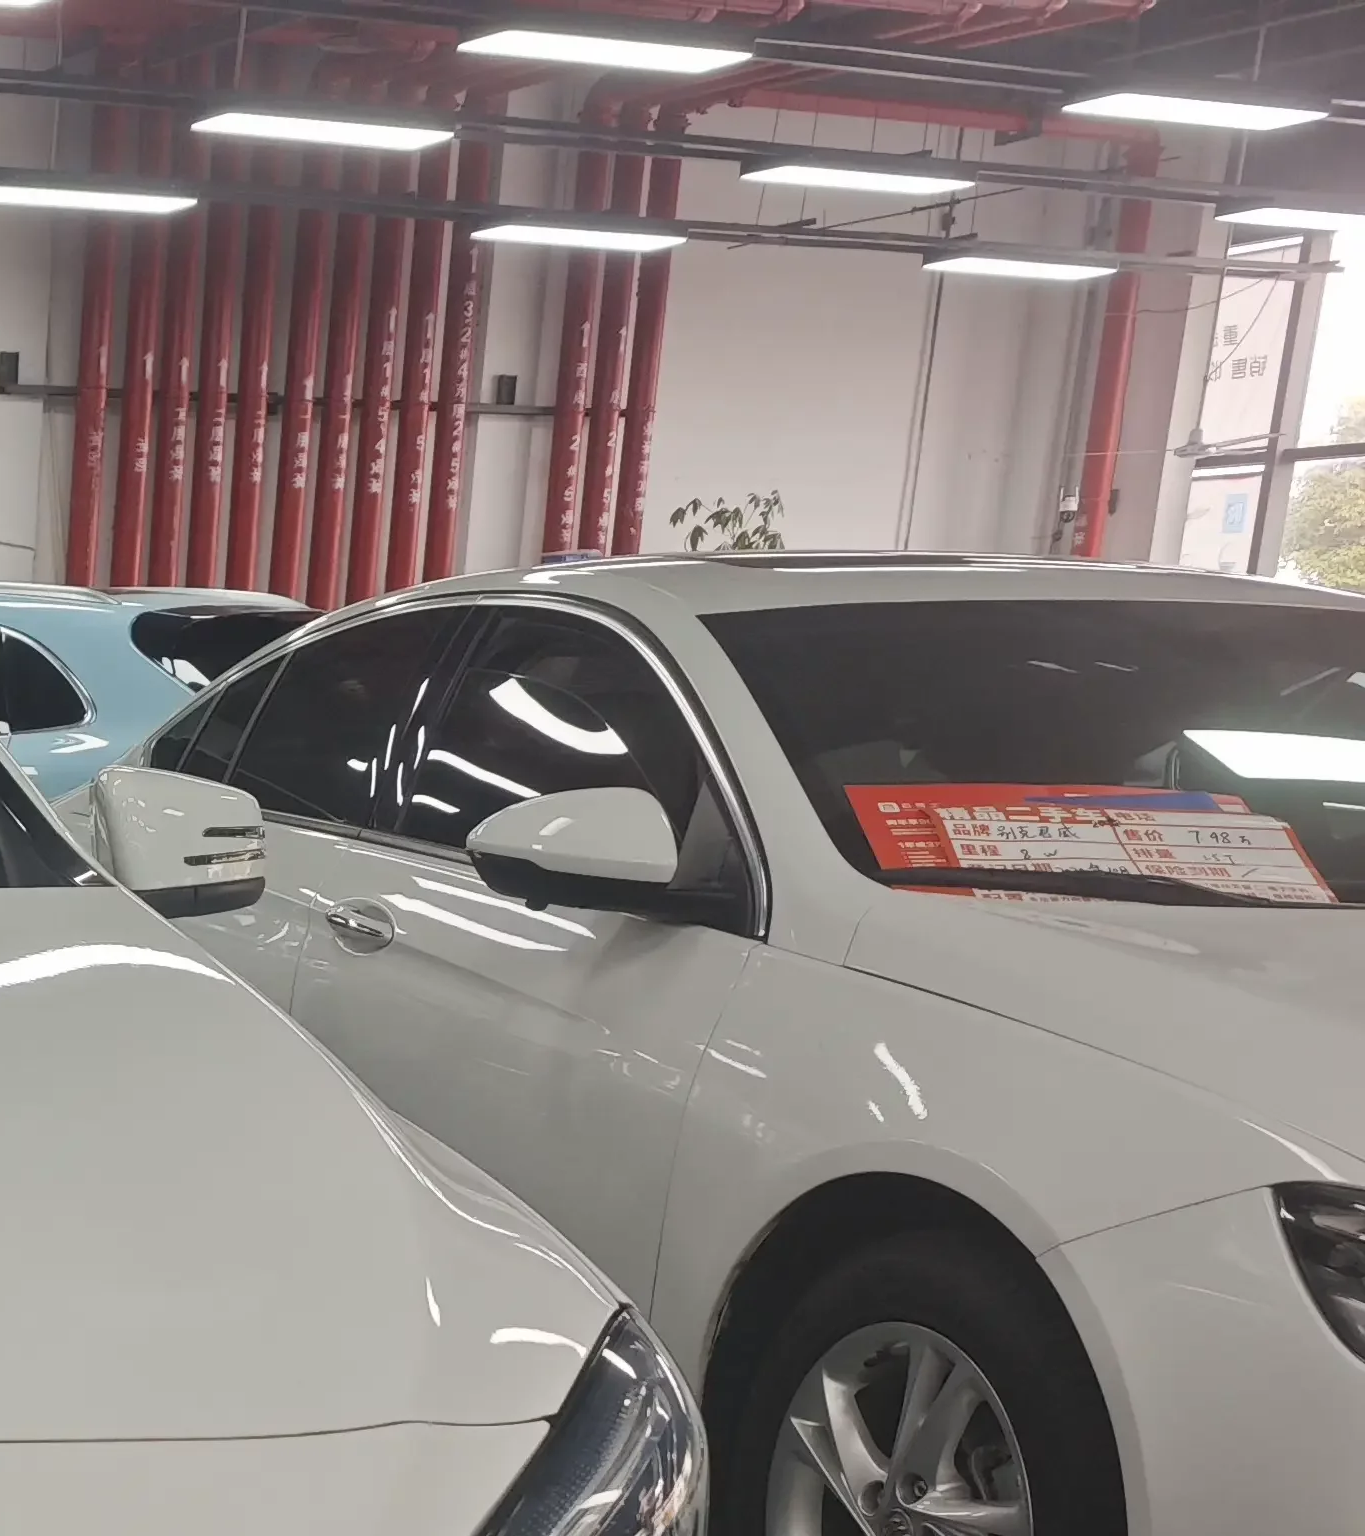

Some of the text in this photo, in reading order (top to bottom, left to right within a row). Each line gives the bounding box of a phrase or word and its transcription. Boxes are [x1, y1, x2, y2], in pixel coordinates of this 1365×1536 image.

[952, 823, 991, 838] 品牌
[1122, 828, 1165, 843] 售价
[959, 842, 1003, 857] 里程
[1132, 848, 1177, 860] 排量
[1144, 864, 1232, 878] 保险到期
